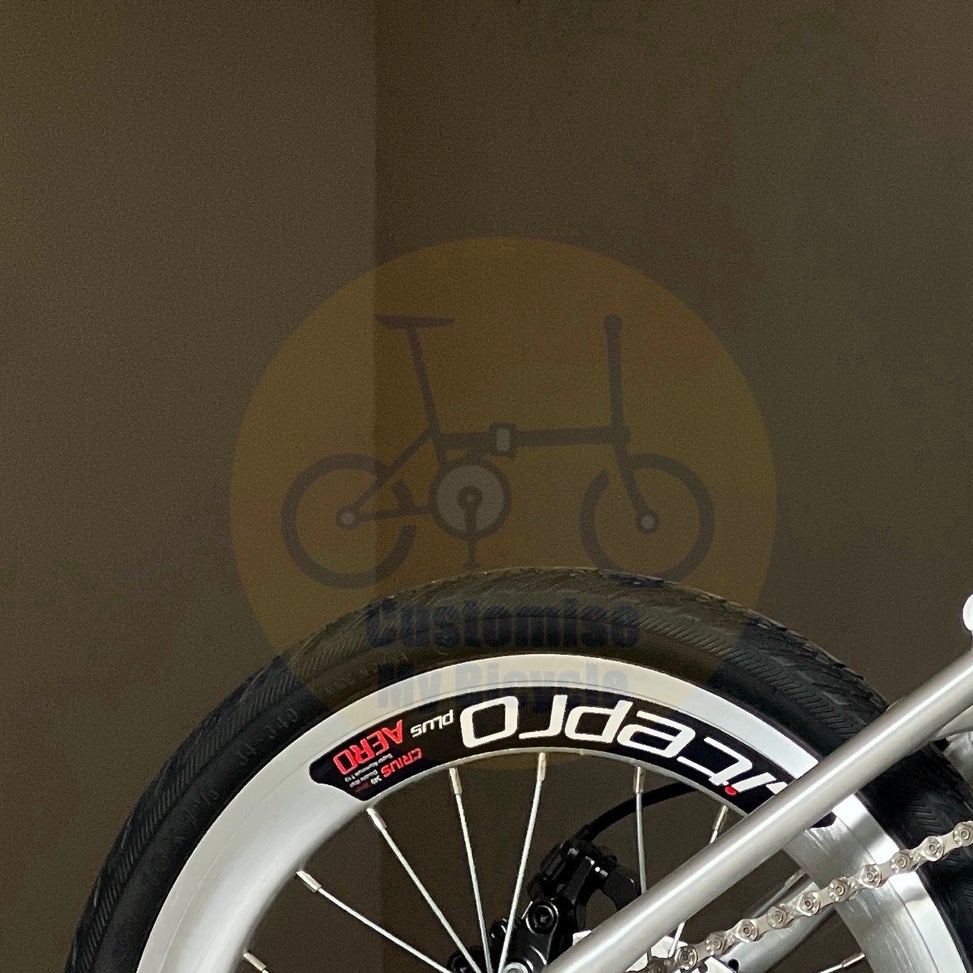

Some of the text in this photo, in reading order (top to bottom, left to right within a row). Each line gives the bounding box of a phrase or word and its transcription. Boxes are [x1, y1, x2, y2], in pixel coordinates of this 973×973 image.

[410, 709, 454, 738] plus
[333, 719, 404, 775] AERO
[381, 747, 423, 778] CRIUS
